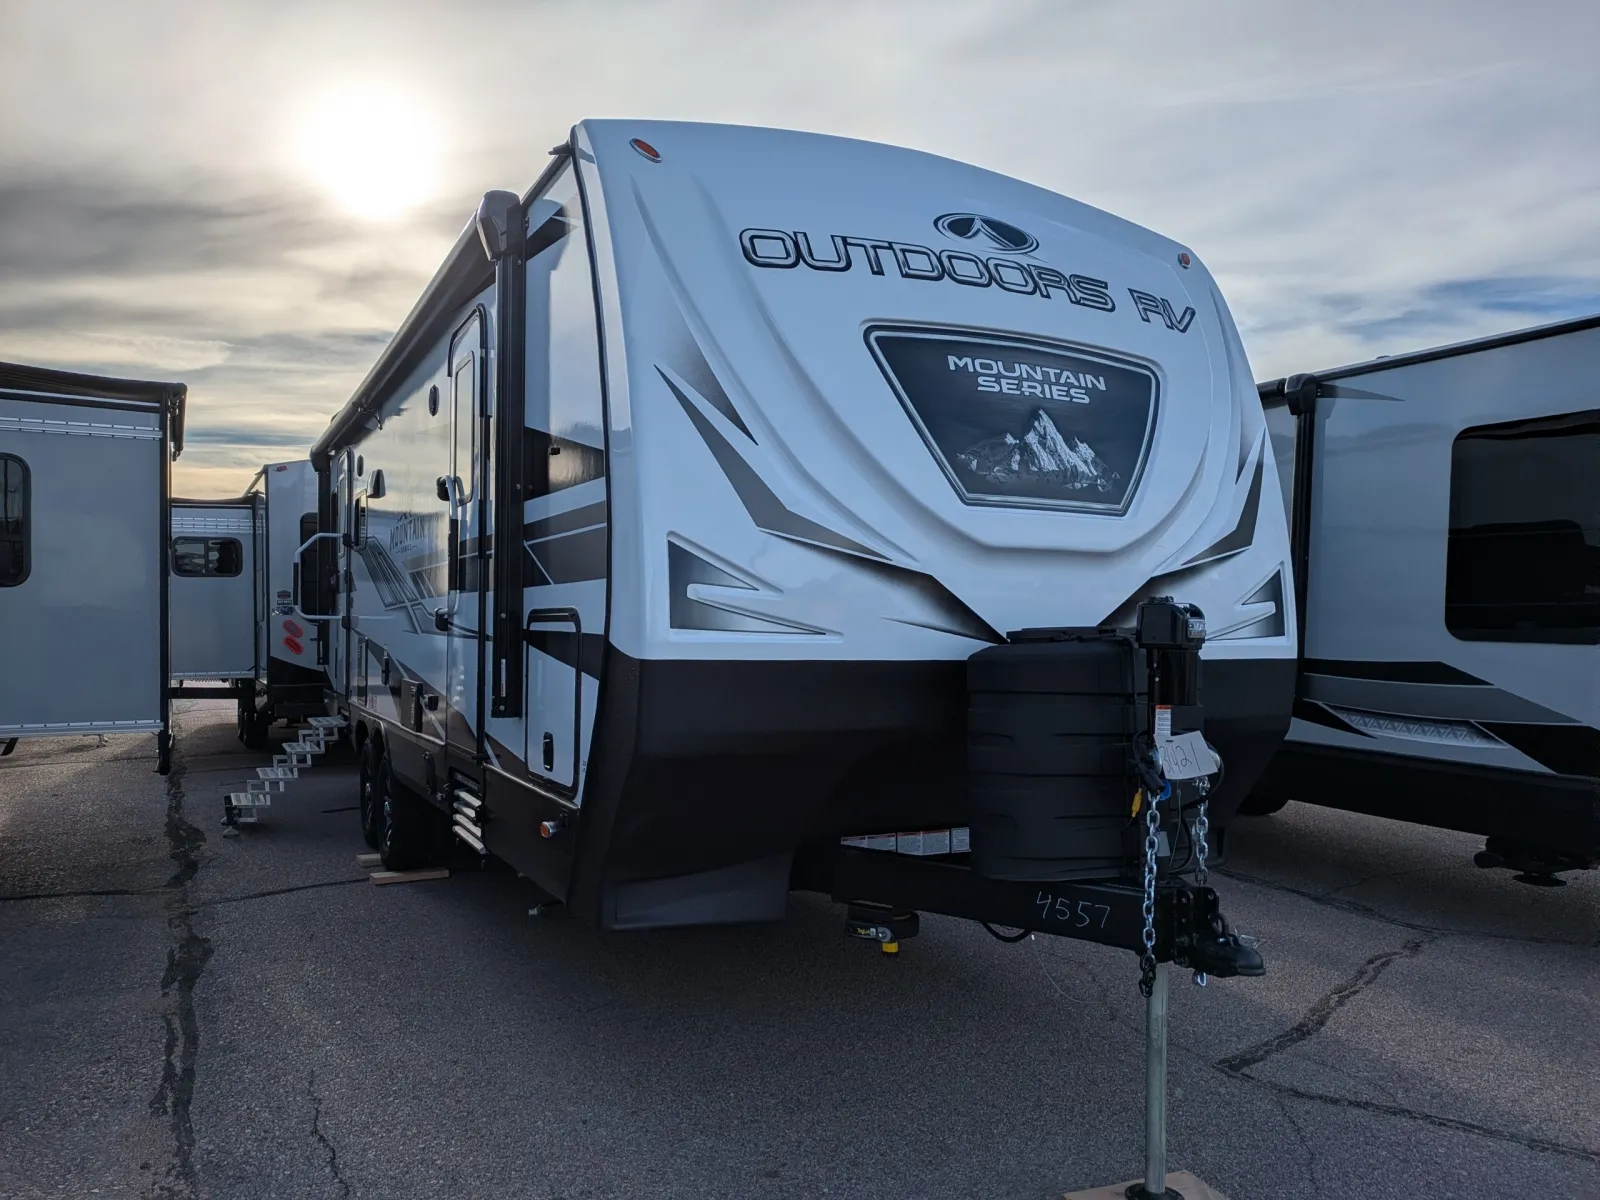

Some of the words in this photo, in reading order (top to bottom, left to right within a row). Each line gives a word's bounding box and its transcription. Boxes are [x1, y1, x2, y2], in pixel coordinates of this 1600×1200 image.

[739, 227, 1116, 313] OUTDOORS
[1128, 287, 1196, 334] RV
[948, 355, 1107, 391] MOUNTAIN
[977, 376, 1090, 404] SERIES
[1037, 890, 1110, 929] 4557
